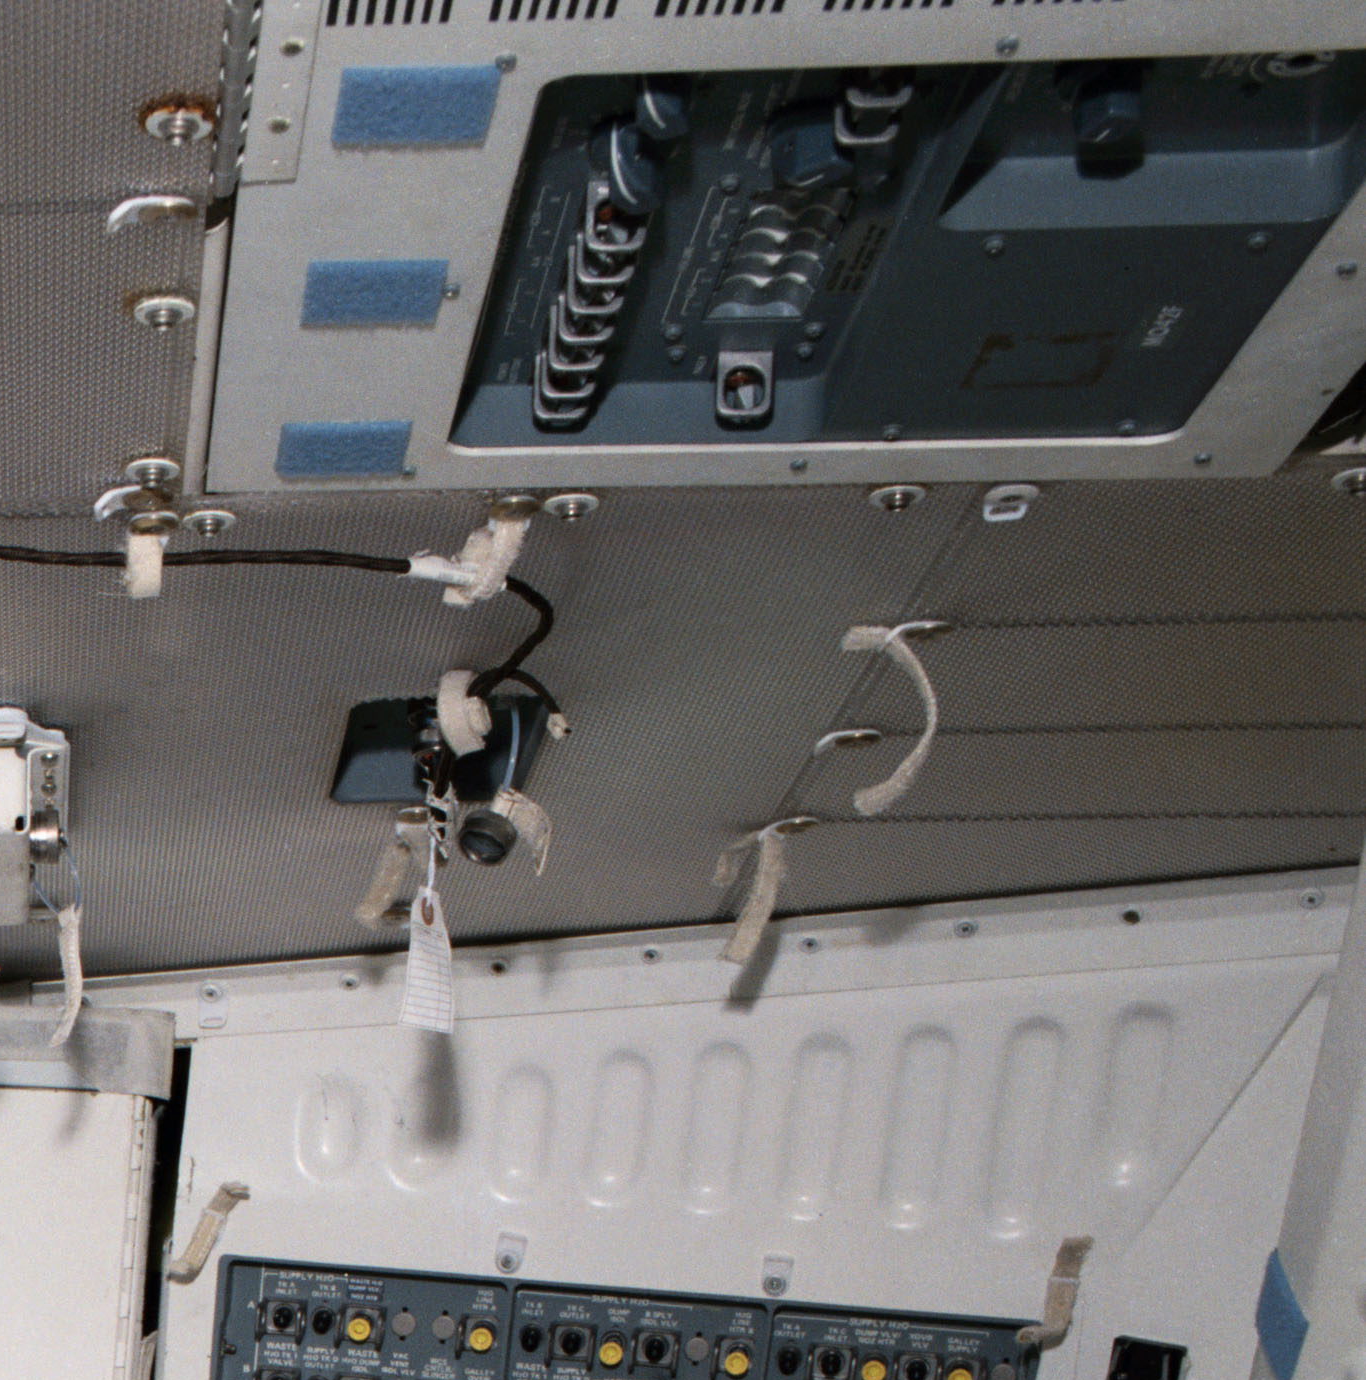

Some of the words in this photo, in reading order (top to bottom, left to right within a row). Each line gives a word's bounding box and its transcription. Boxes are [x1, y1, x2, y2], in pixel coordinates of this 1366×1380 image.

[522, 1307, 543, 1316] INLET
[560, 1311, 590, 1319] OUTLET
[774, 1328, 805, 1338] OUTLET
[267, 1342, 296, 1351] WASTE
[948, 1337, 979, 1347] GALLEY
[348, 1349, 377, 1358] WASTE
[305, 1360, 334, 1368] OUTLET
[516, 1363, 546, 1371] WASTE
